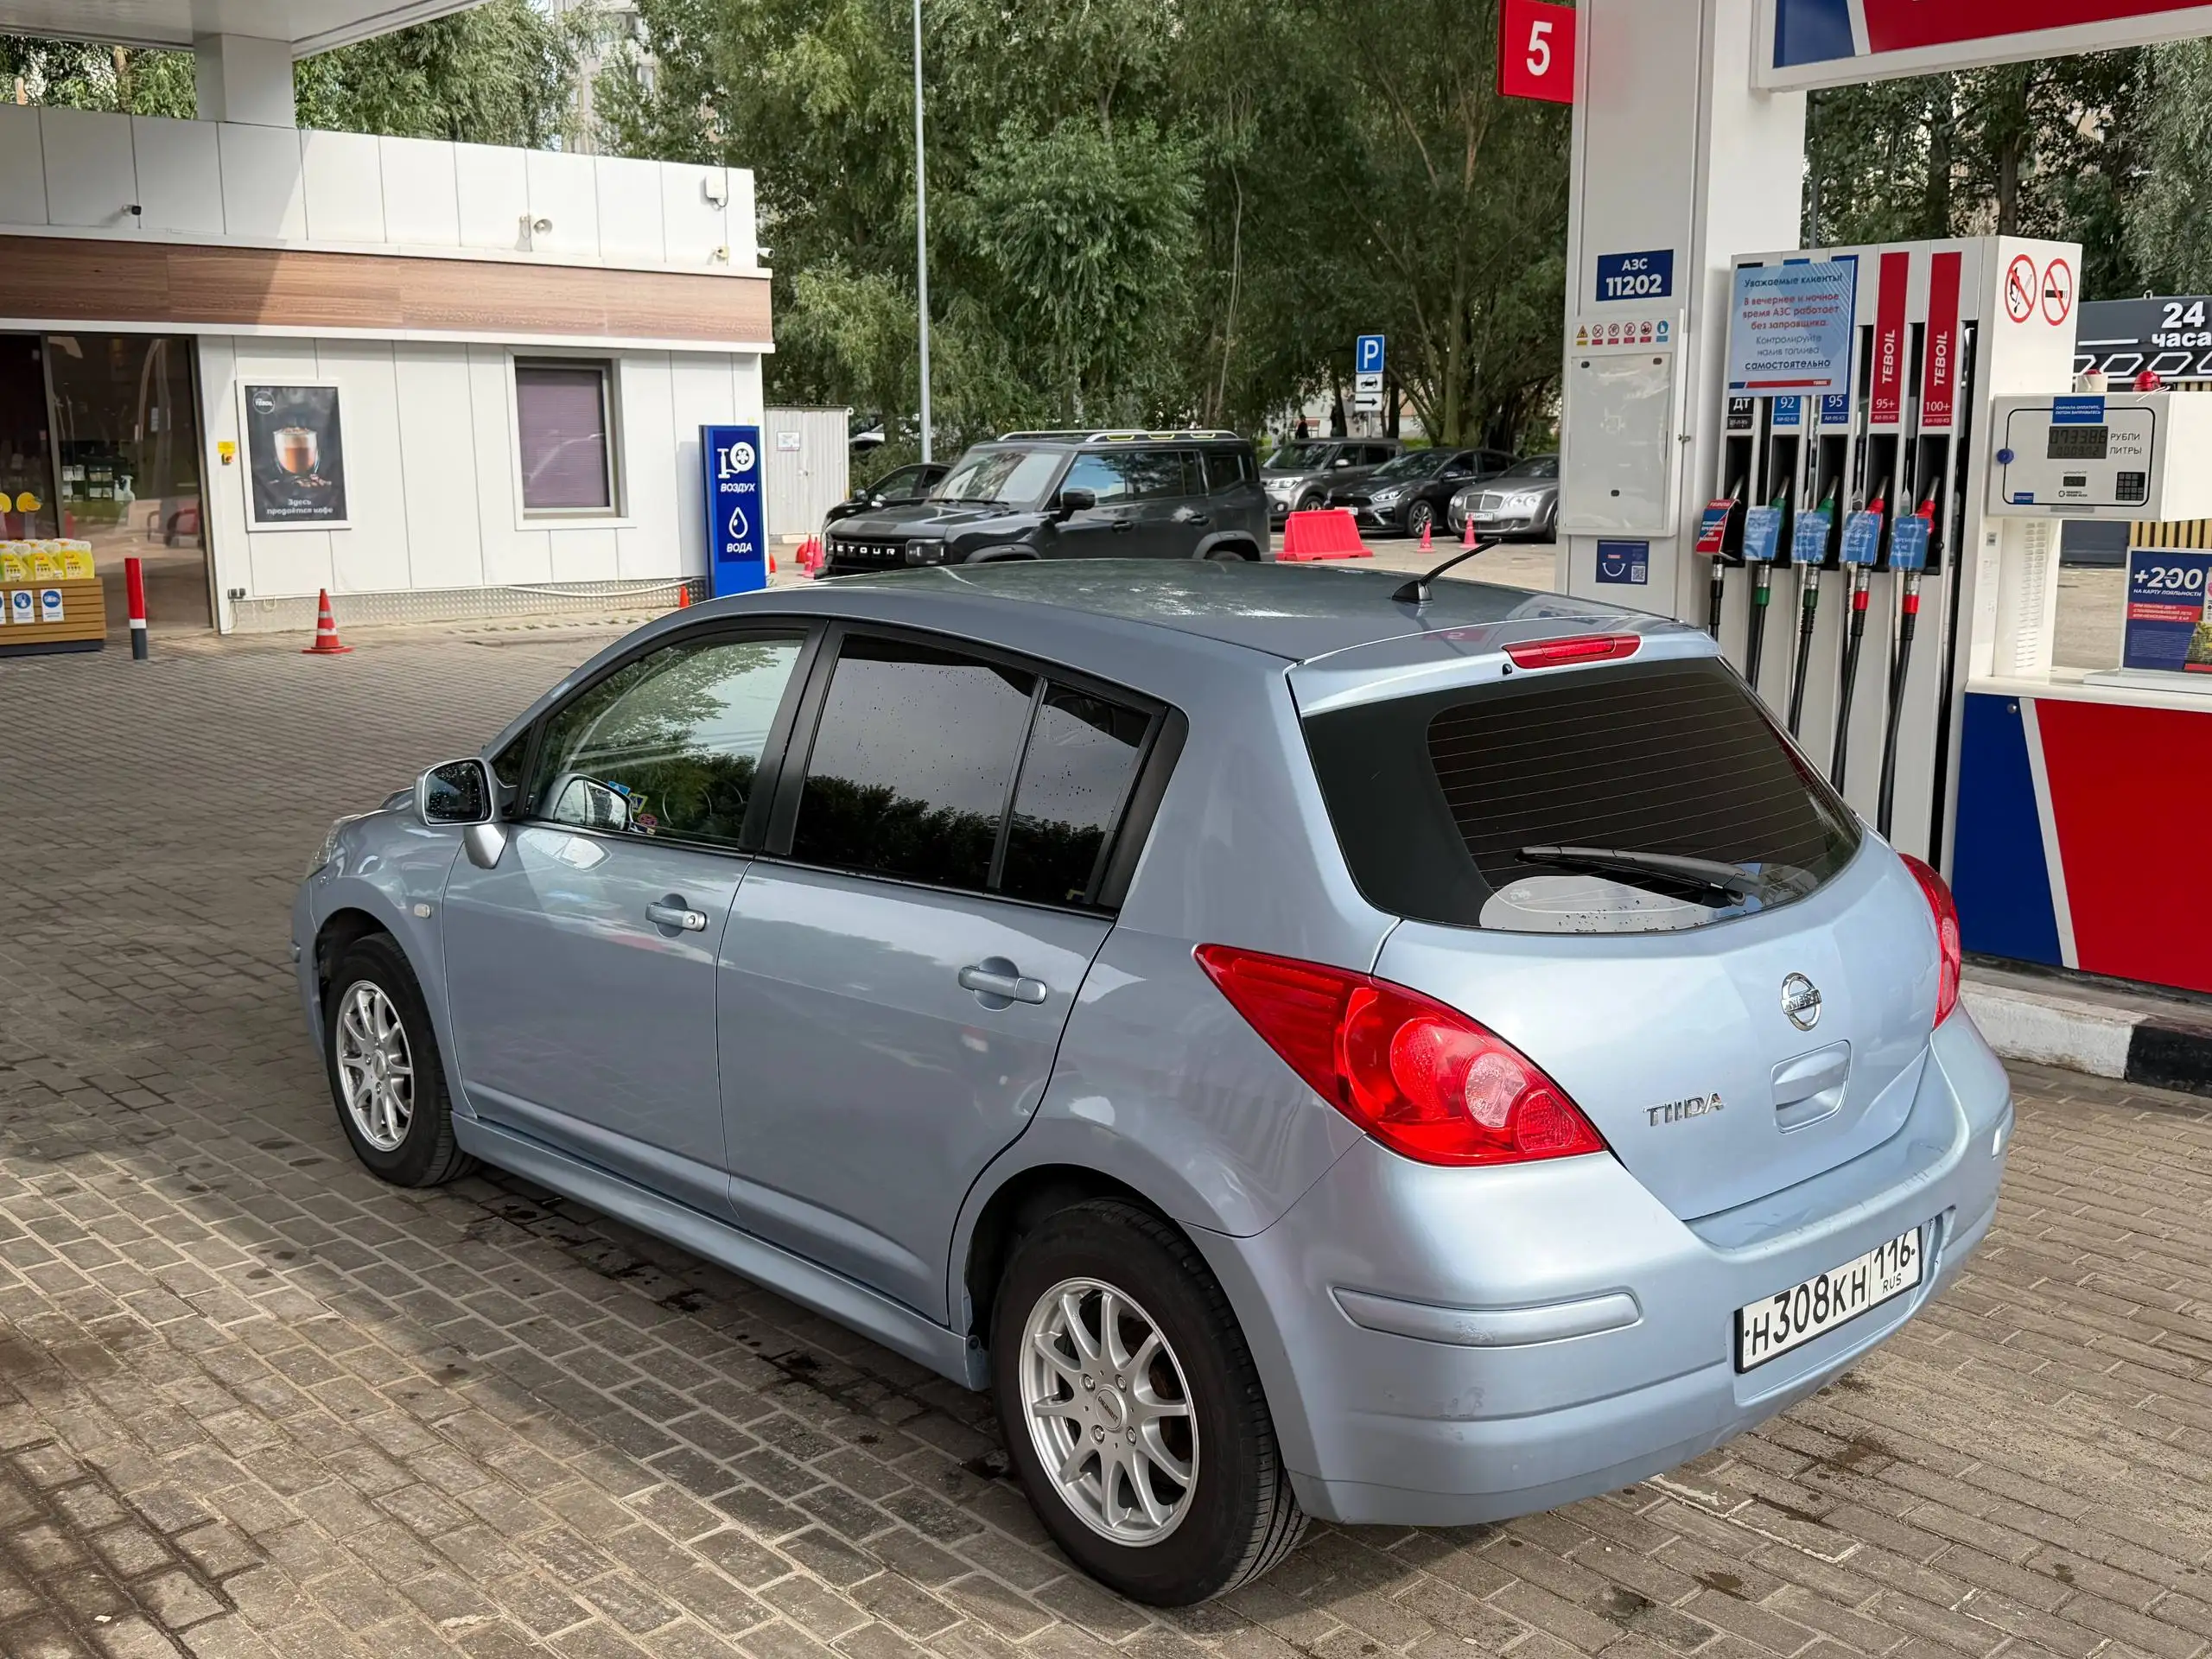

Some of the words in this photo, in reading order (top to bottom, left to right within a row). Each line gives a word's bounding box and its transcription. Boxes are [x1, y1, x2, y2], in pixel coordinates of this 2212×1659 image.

[1527, 21, 1553, 76] 5
[1622, 258, 1648, 271] АЗС
[1606, 274, 1662, 296] 11202
[1744, 277, 1798, 288] Уважаемые
[1802, 272, 1842, 283] клиенты!
[1751, 296, 1796, 306] вечернее
[1805, 293, 1839, 302] ночное
[1743, 310, 1770, 320] время
[1773, 308, 1791, 316] АЗС
[1794, 306, 1839, 316] работает
[2161, 302, 2206, 328] 24
[1751, 321, 1766, 330] без
[1756, 334, 1821, 346] Контролируйте
[2152, 331, 2212, 347] часа
[1363, 340, 1379, 369] P
[1784, 346, 1820, 355] топлива
[1882, 329, 1896, 385] TEBOIL
[1745, 359, 1831, 370] самостоятельно
[1934, 331, 1948, 386] TEBOIL
[1733, 397, 1751, 410] ДТ
[1780, 397, 1795, 409] 92
[1828, 396, 1843, 407] 95
[1876, 398, 1895, 409] 95+
[1926, 401, 1950, 411] 100+
[721, 483, 755, 493] ВОЗДУХ
[727, 543, 753, 553] ВОДА
[2134, 567, 2203, 589] +200
[1643, 1092, 1725, 1127] TIIDA
[1874, 1234, 1910, 1280] 116
[1883, 1273, 1902, 1294] RUS
